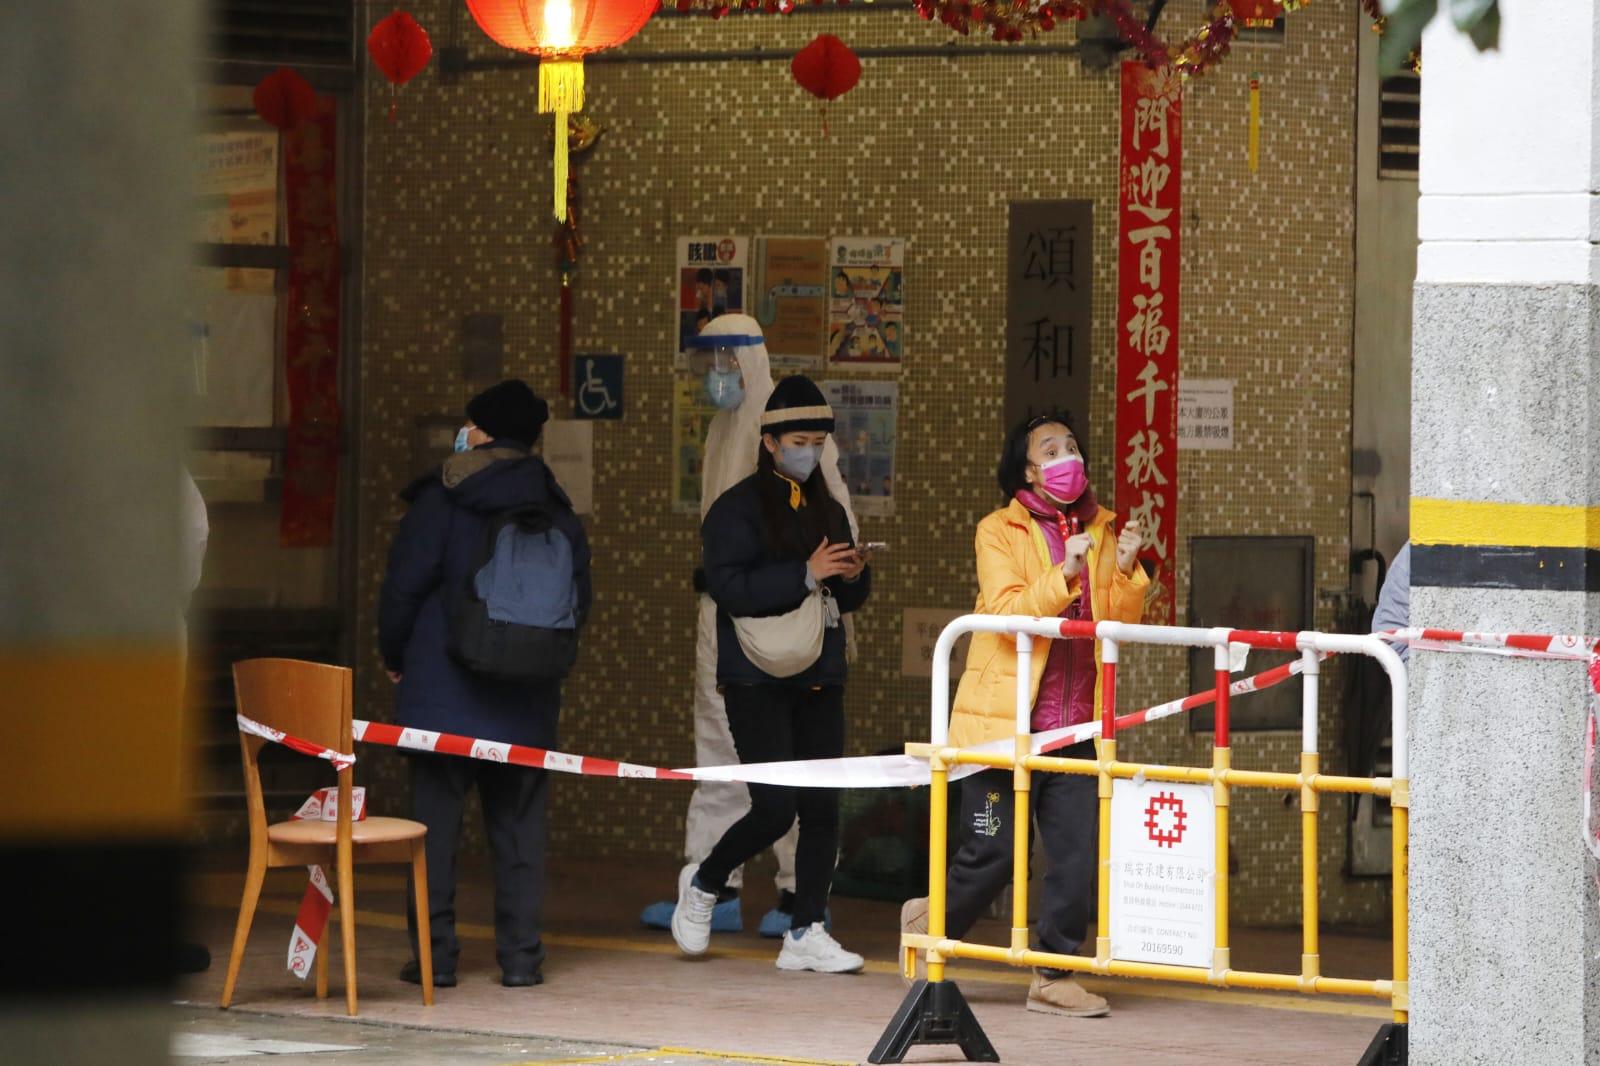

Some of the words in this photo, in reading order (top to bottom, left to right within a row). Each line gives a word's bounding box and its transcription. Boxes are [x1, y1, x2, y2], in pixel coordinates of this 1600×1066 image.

[1022, 225, 1077, 425] 頌和
[1123, 863, 1204, 882] 瑞安承建有限公司
[1141, 942, 1184, 956] 20169590
